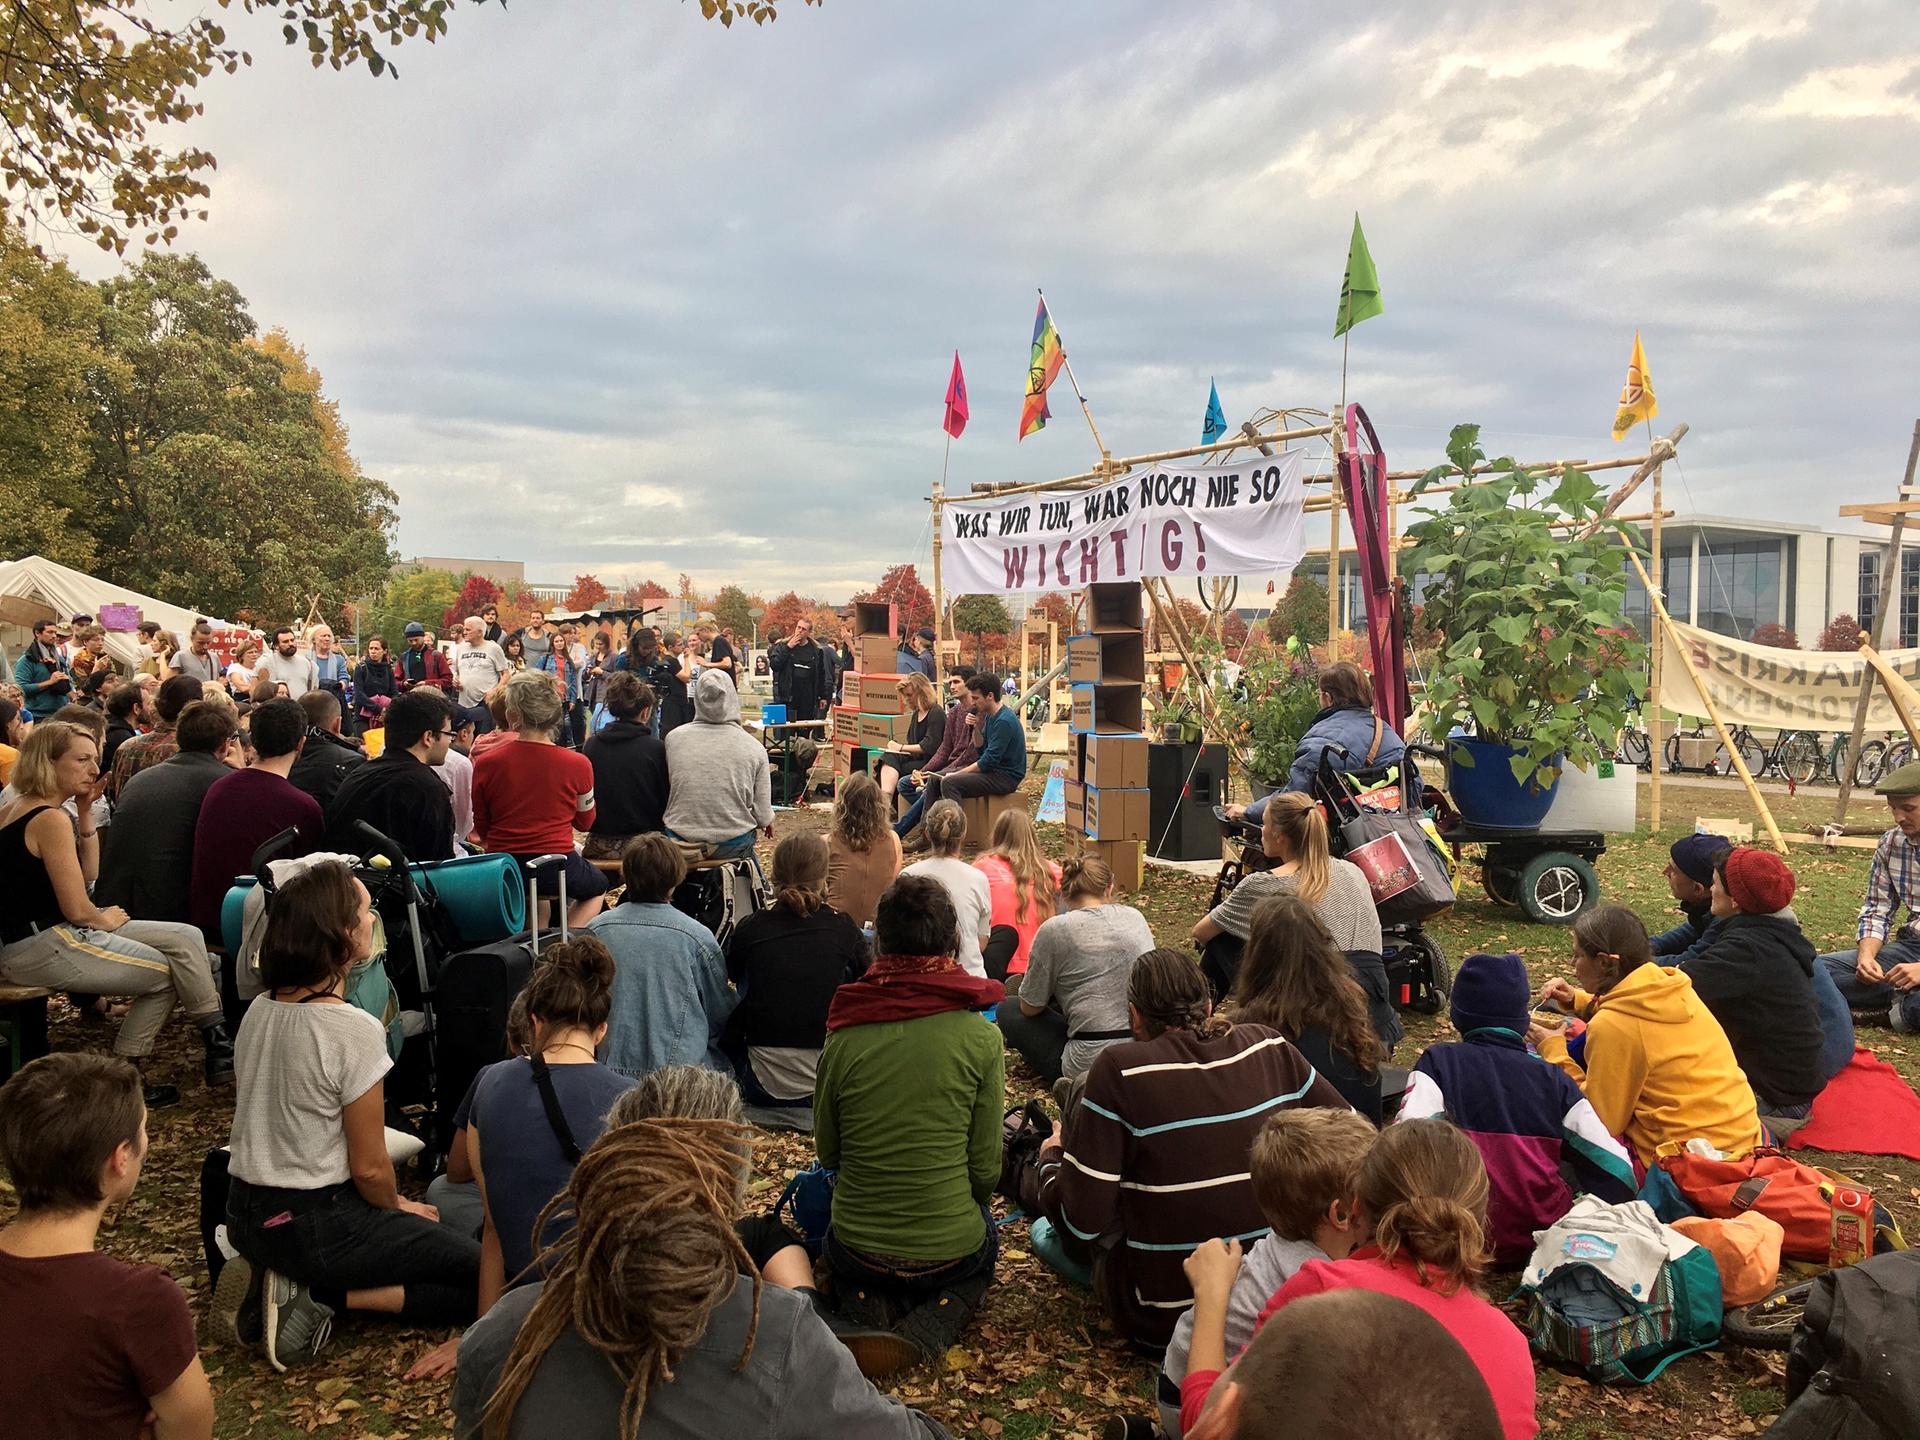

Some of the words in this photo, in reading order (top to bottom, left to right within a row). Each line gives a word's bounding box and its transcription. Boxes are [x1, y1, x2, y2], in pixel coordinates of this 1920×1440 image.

[955, 512, 991, 538] WAS
[999, 506, 1031, 536] WIR
[1039, 501, 1073, 533] TUN,
[1084, 486, 1129, 524] WAR
[1140, 474, 1196, 508] NOCH
[1205, 474, 1239, 508] NIE
[1249, 466, 1280, 504] SO
[1003, 520, 1206, 588] WICHTIG!
